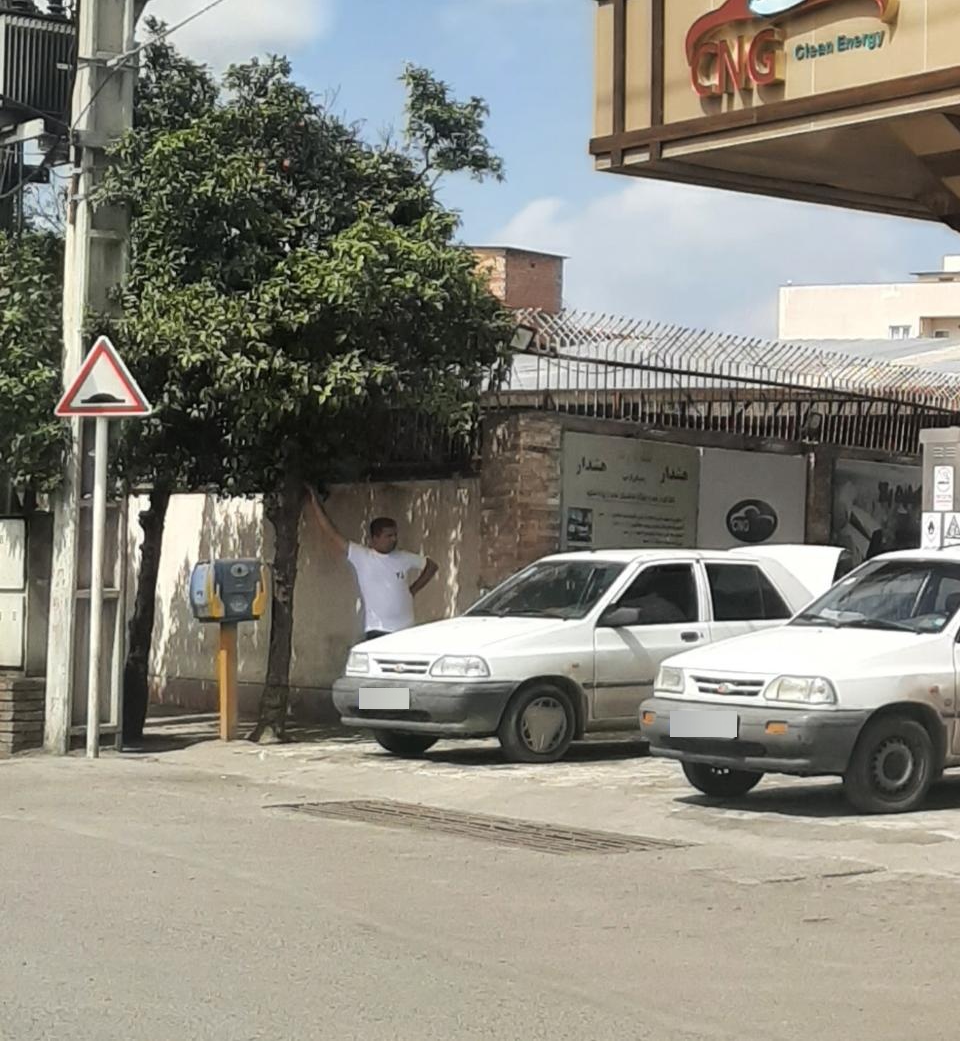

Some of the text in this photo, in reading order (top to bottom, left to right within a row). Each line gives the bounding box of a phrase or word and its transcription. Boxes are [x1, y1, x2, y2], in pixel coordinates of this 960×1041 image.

[690, 27, 780, 97] CNG
[794, 30, 885, 61] Clean Energy
